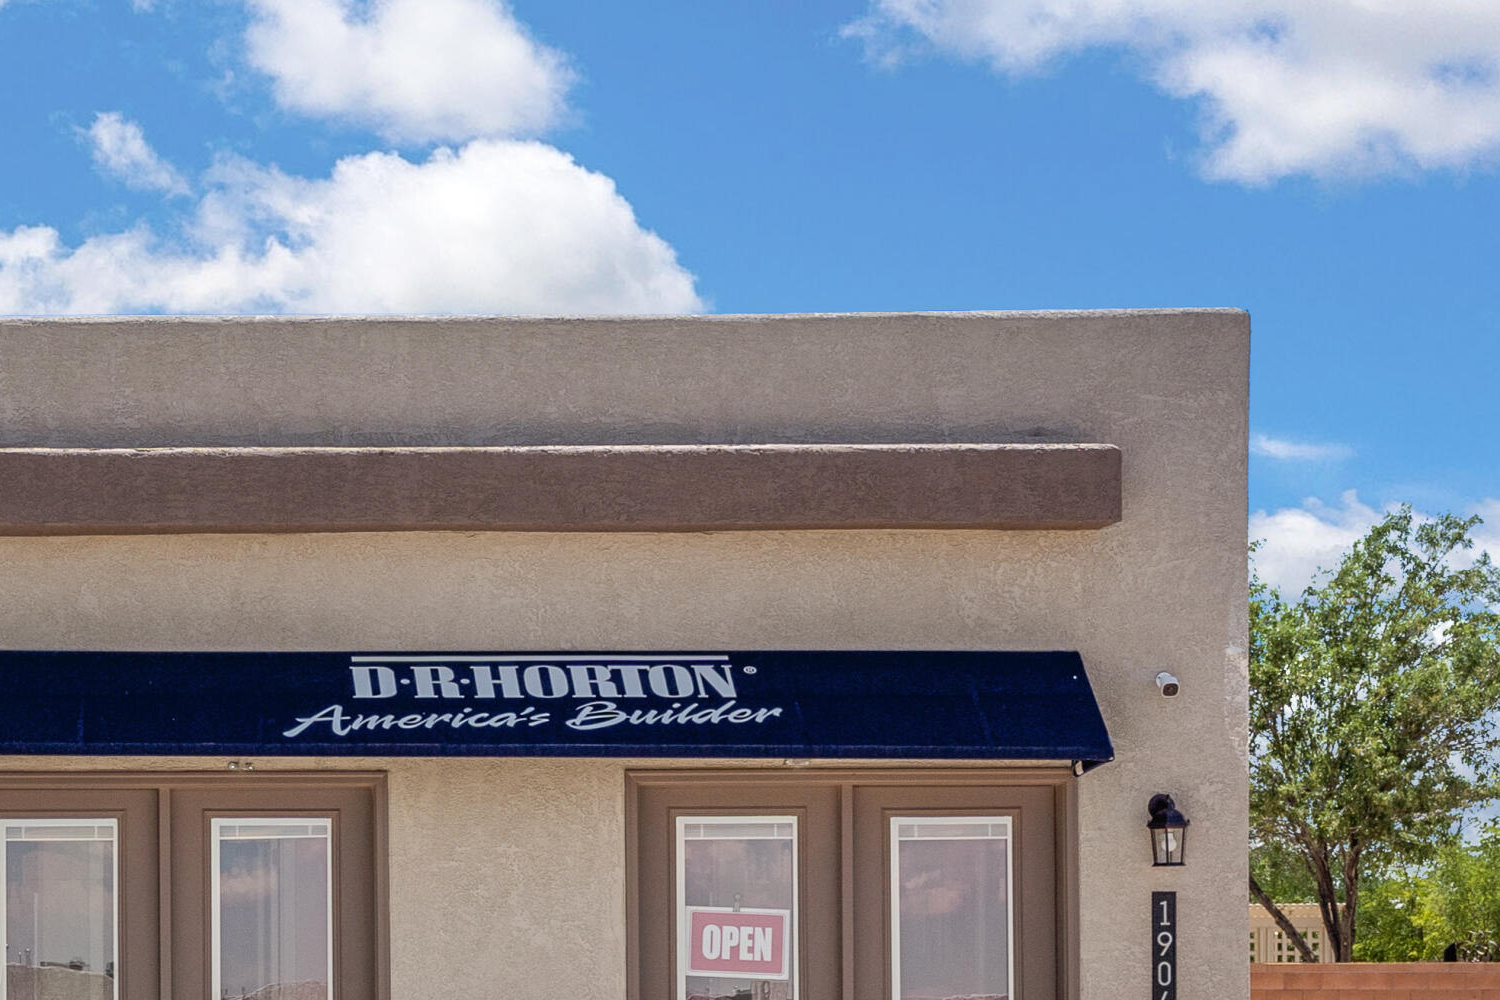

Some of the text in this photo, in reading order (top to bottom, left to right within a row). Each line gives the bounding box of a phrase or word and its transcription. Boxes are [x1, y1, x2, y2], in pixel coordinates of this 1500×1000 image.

[282, 700, 783, 738] America's Builder
[701, 923, 773, 962] OPEN
